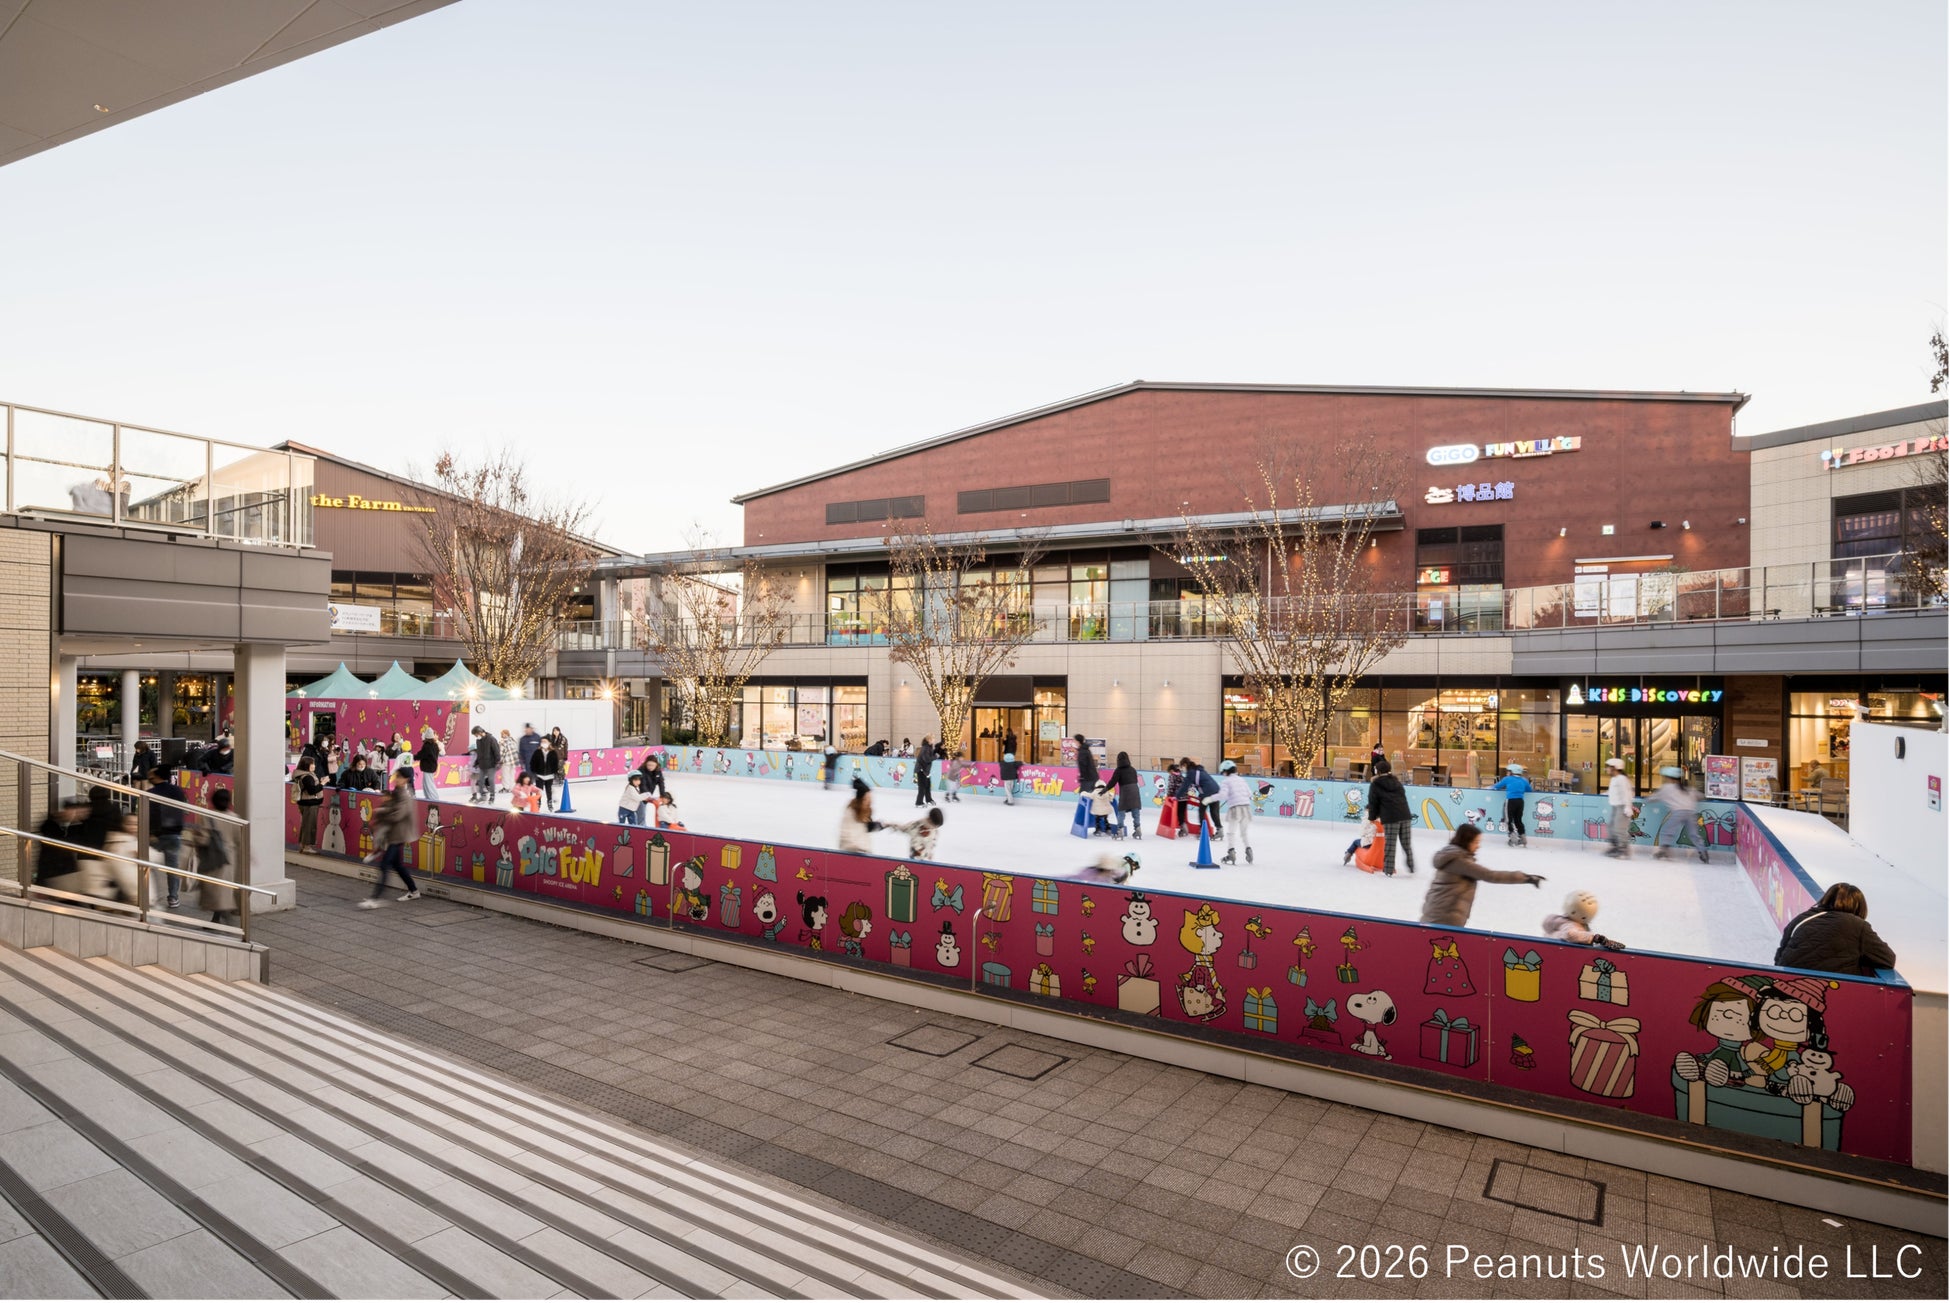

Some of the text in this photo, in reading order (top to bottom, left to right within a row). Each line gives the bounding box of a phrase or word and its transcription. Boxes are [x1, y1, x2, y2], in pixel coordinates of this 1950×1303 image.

[1430, 447, 1476, 462] GiGO
[1485, 436, 1582, 457] FUN VILLAGE
[1849, 441, 1908, 465] Food
[1456, 481, 1515, 503] 博品館
[310, 494, 343, 508] the
[347, 495, 402, 511] Farm
[1417, 570, 1449, 584] AGE
[1021, 769, 1046, 778] WINTER
[1033, 777, 1064, 796] FUN
[543, 827, 577, 845] WINTER
[518, 835, 604, 887] BIG FUN
